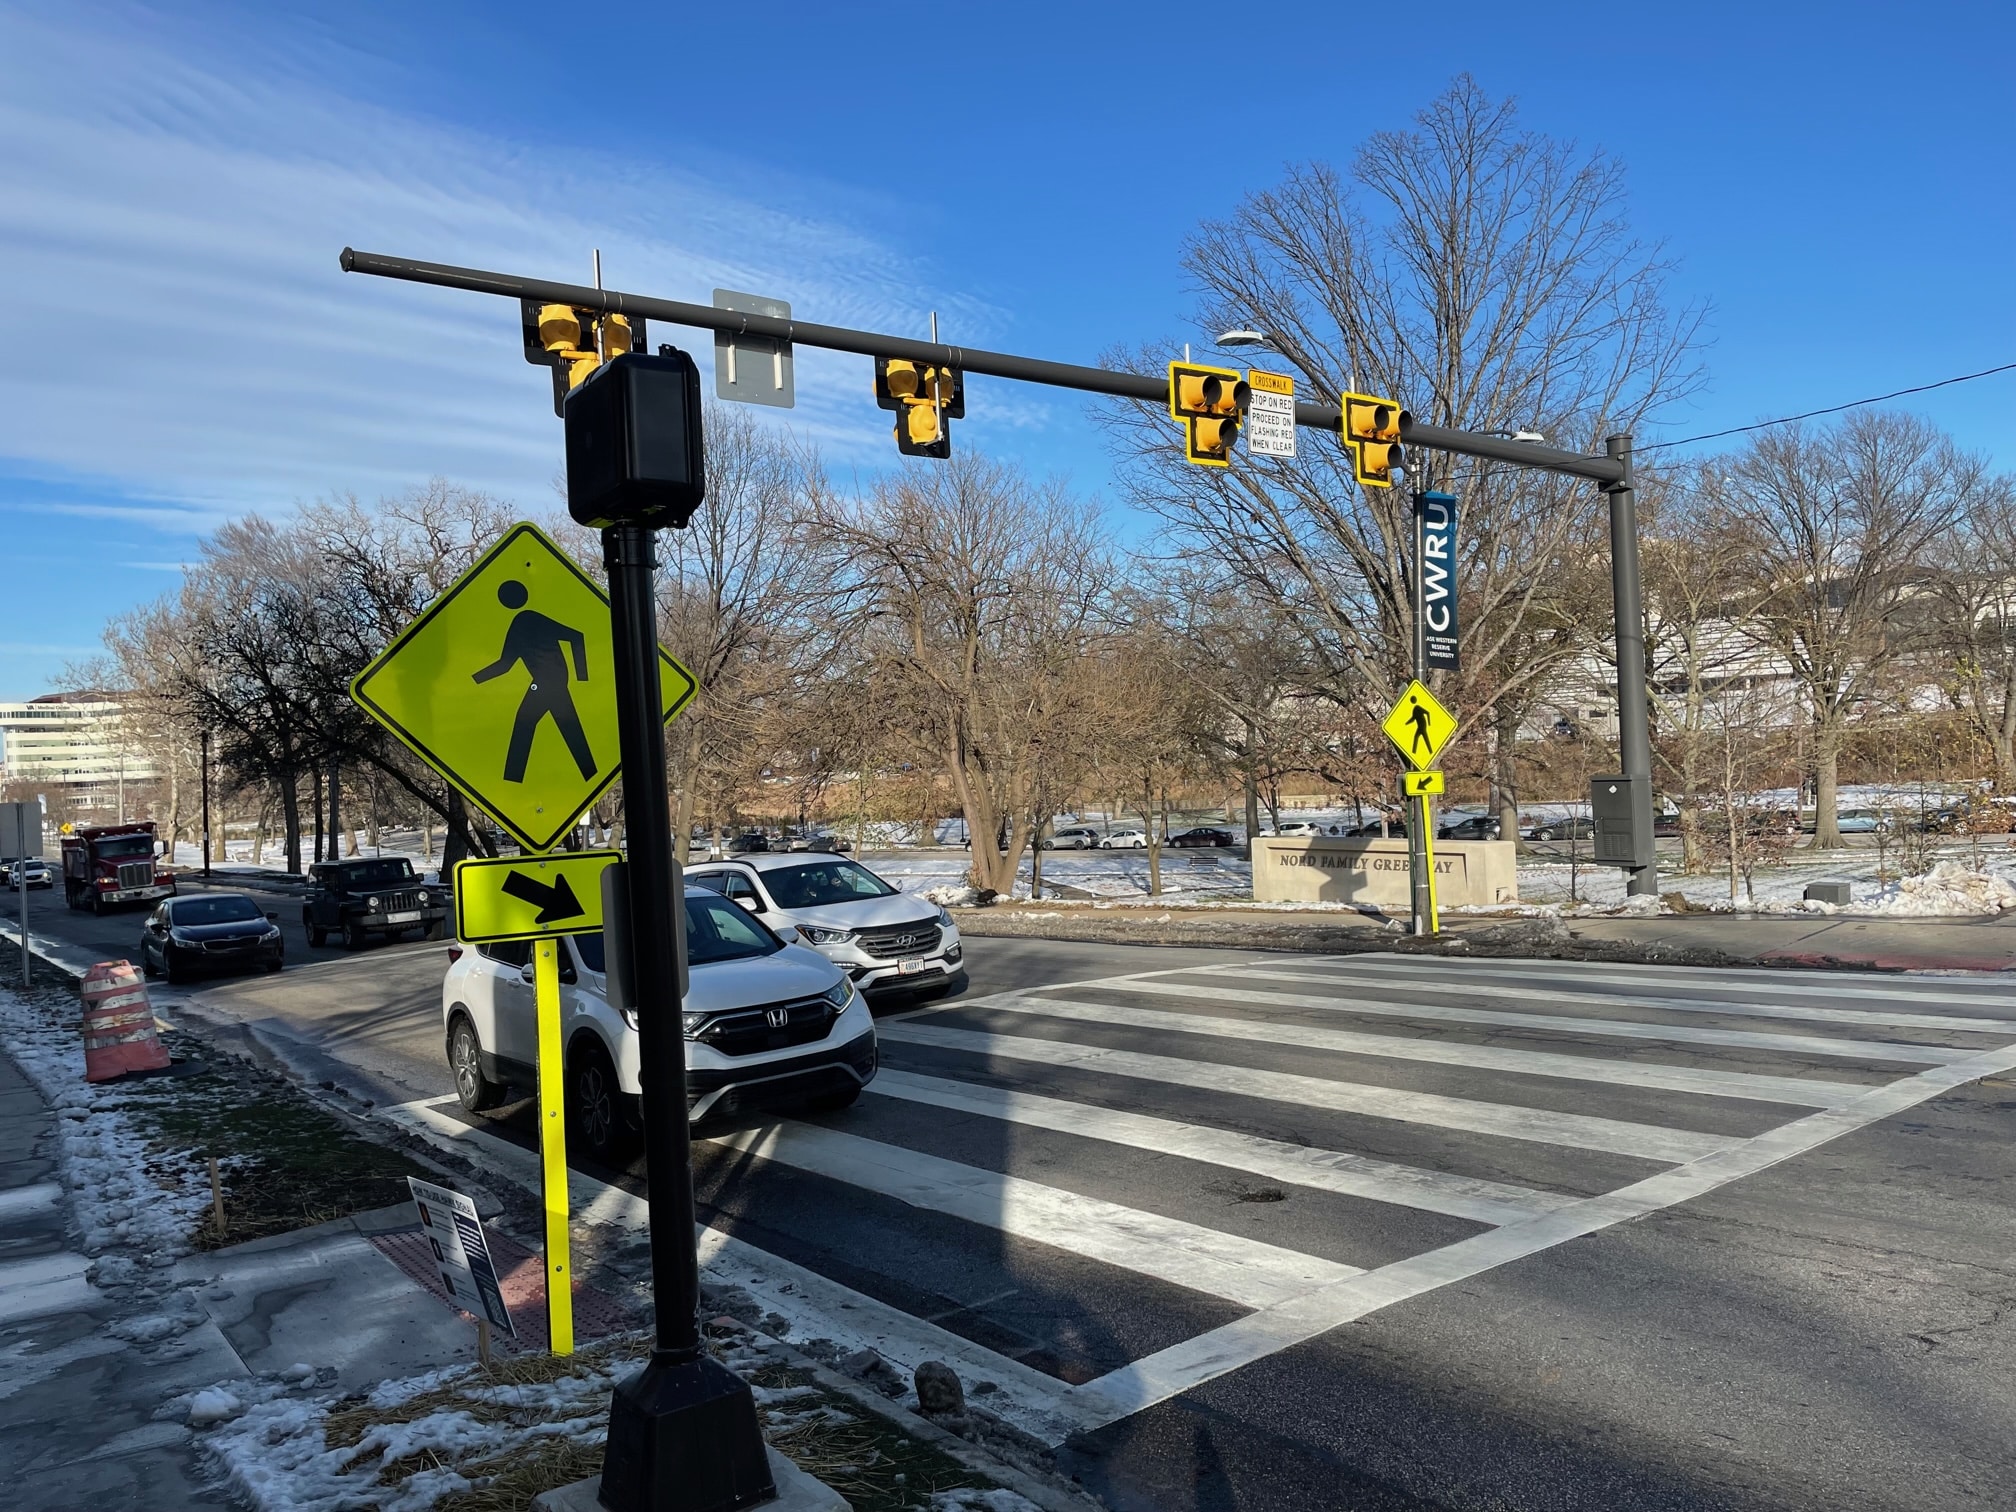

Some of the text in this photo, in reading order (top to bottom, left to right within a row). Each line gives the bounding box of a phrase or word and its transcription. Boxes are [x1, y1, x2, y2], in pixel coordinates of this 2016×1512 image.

[1255, 375, 1287, 391] CROSSWALK
[1251, 393, 1292, 410] STOP ON RED
[1252, 412, 1292, 427] PROCEED ON
[1251, 425, 1293, 440] FLASHING RED
[1252, 438, 1292, 452] WHEN CLEAR
[1425, 503, 1450, 632] CWRU
[1428, 650, 1454, 659] UNIVERSITY
[1431, 643, 1451, 651] RESERVE
[1280, 854, 1453, 874] NORD FAMILY GREEAY
